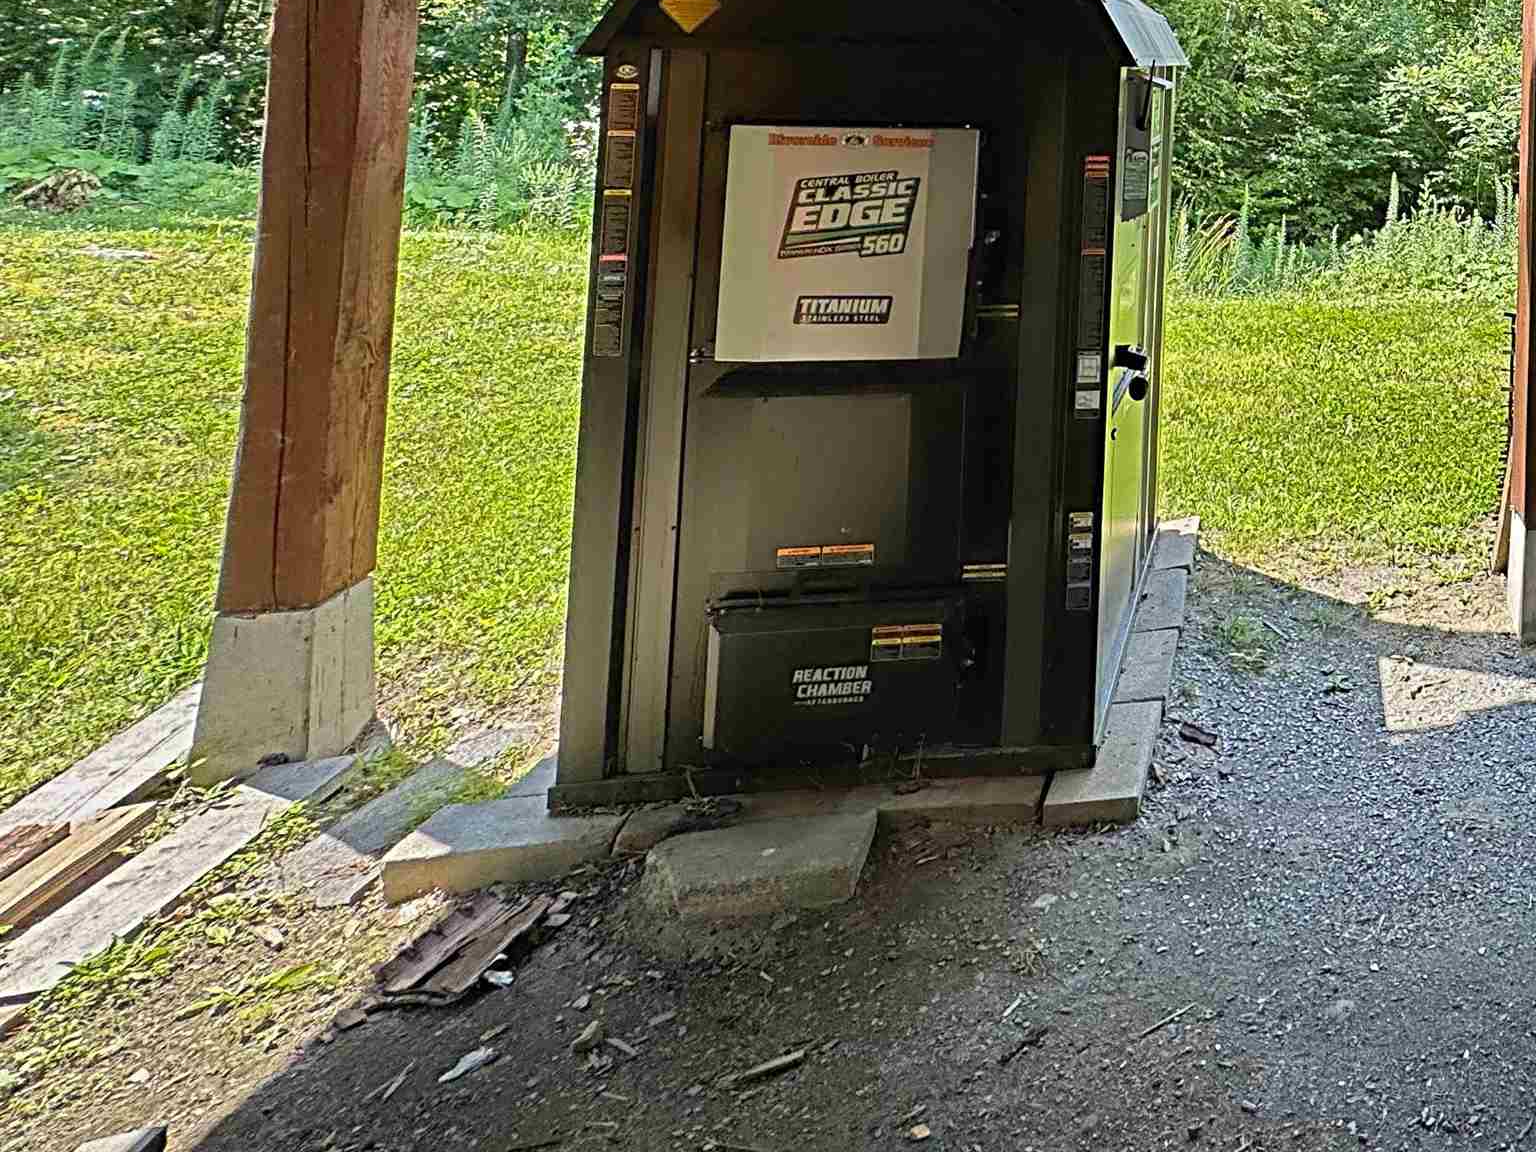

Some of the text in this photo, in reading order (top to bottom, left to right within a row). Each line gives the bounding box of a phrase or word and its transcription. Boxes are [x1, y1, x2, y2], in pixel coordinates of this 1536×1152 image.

[800, 172, 895, 189] CENTRAL BOILER
[798, 180, 914, 204] CLASSIC
[789, 197, 911, 233] EDGE
[861, 233, 905, 256] 560
[799, 298, 890, 314] TITANIUM
[792, 665, 868, 684] REACTION
[797, 680, 872, 698] CHAMBER
